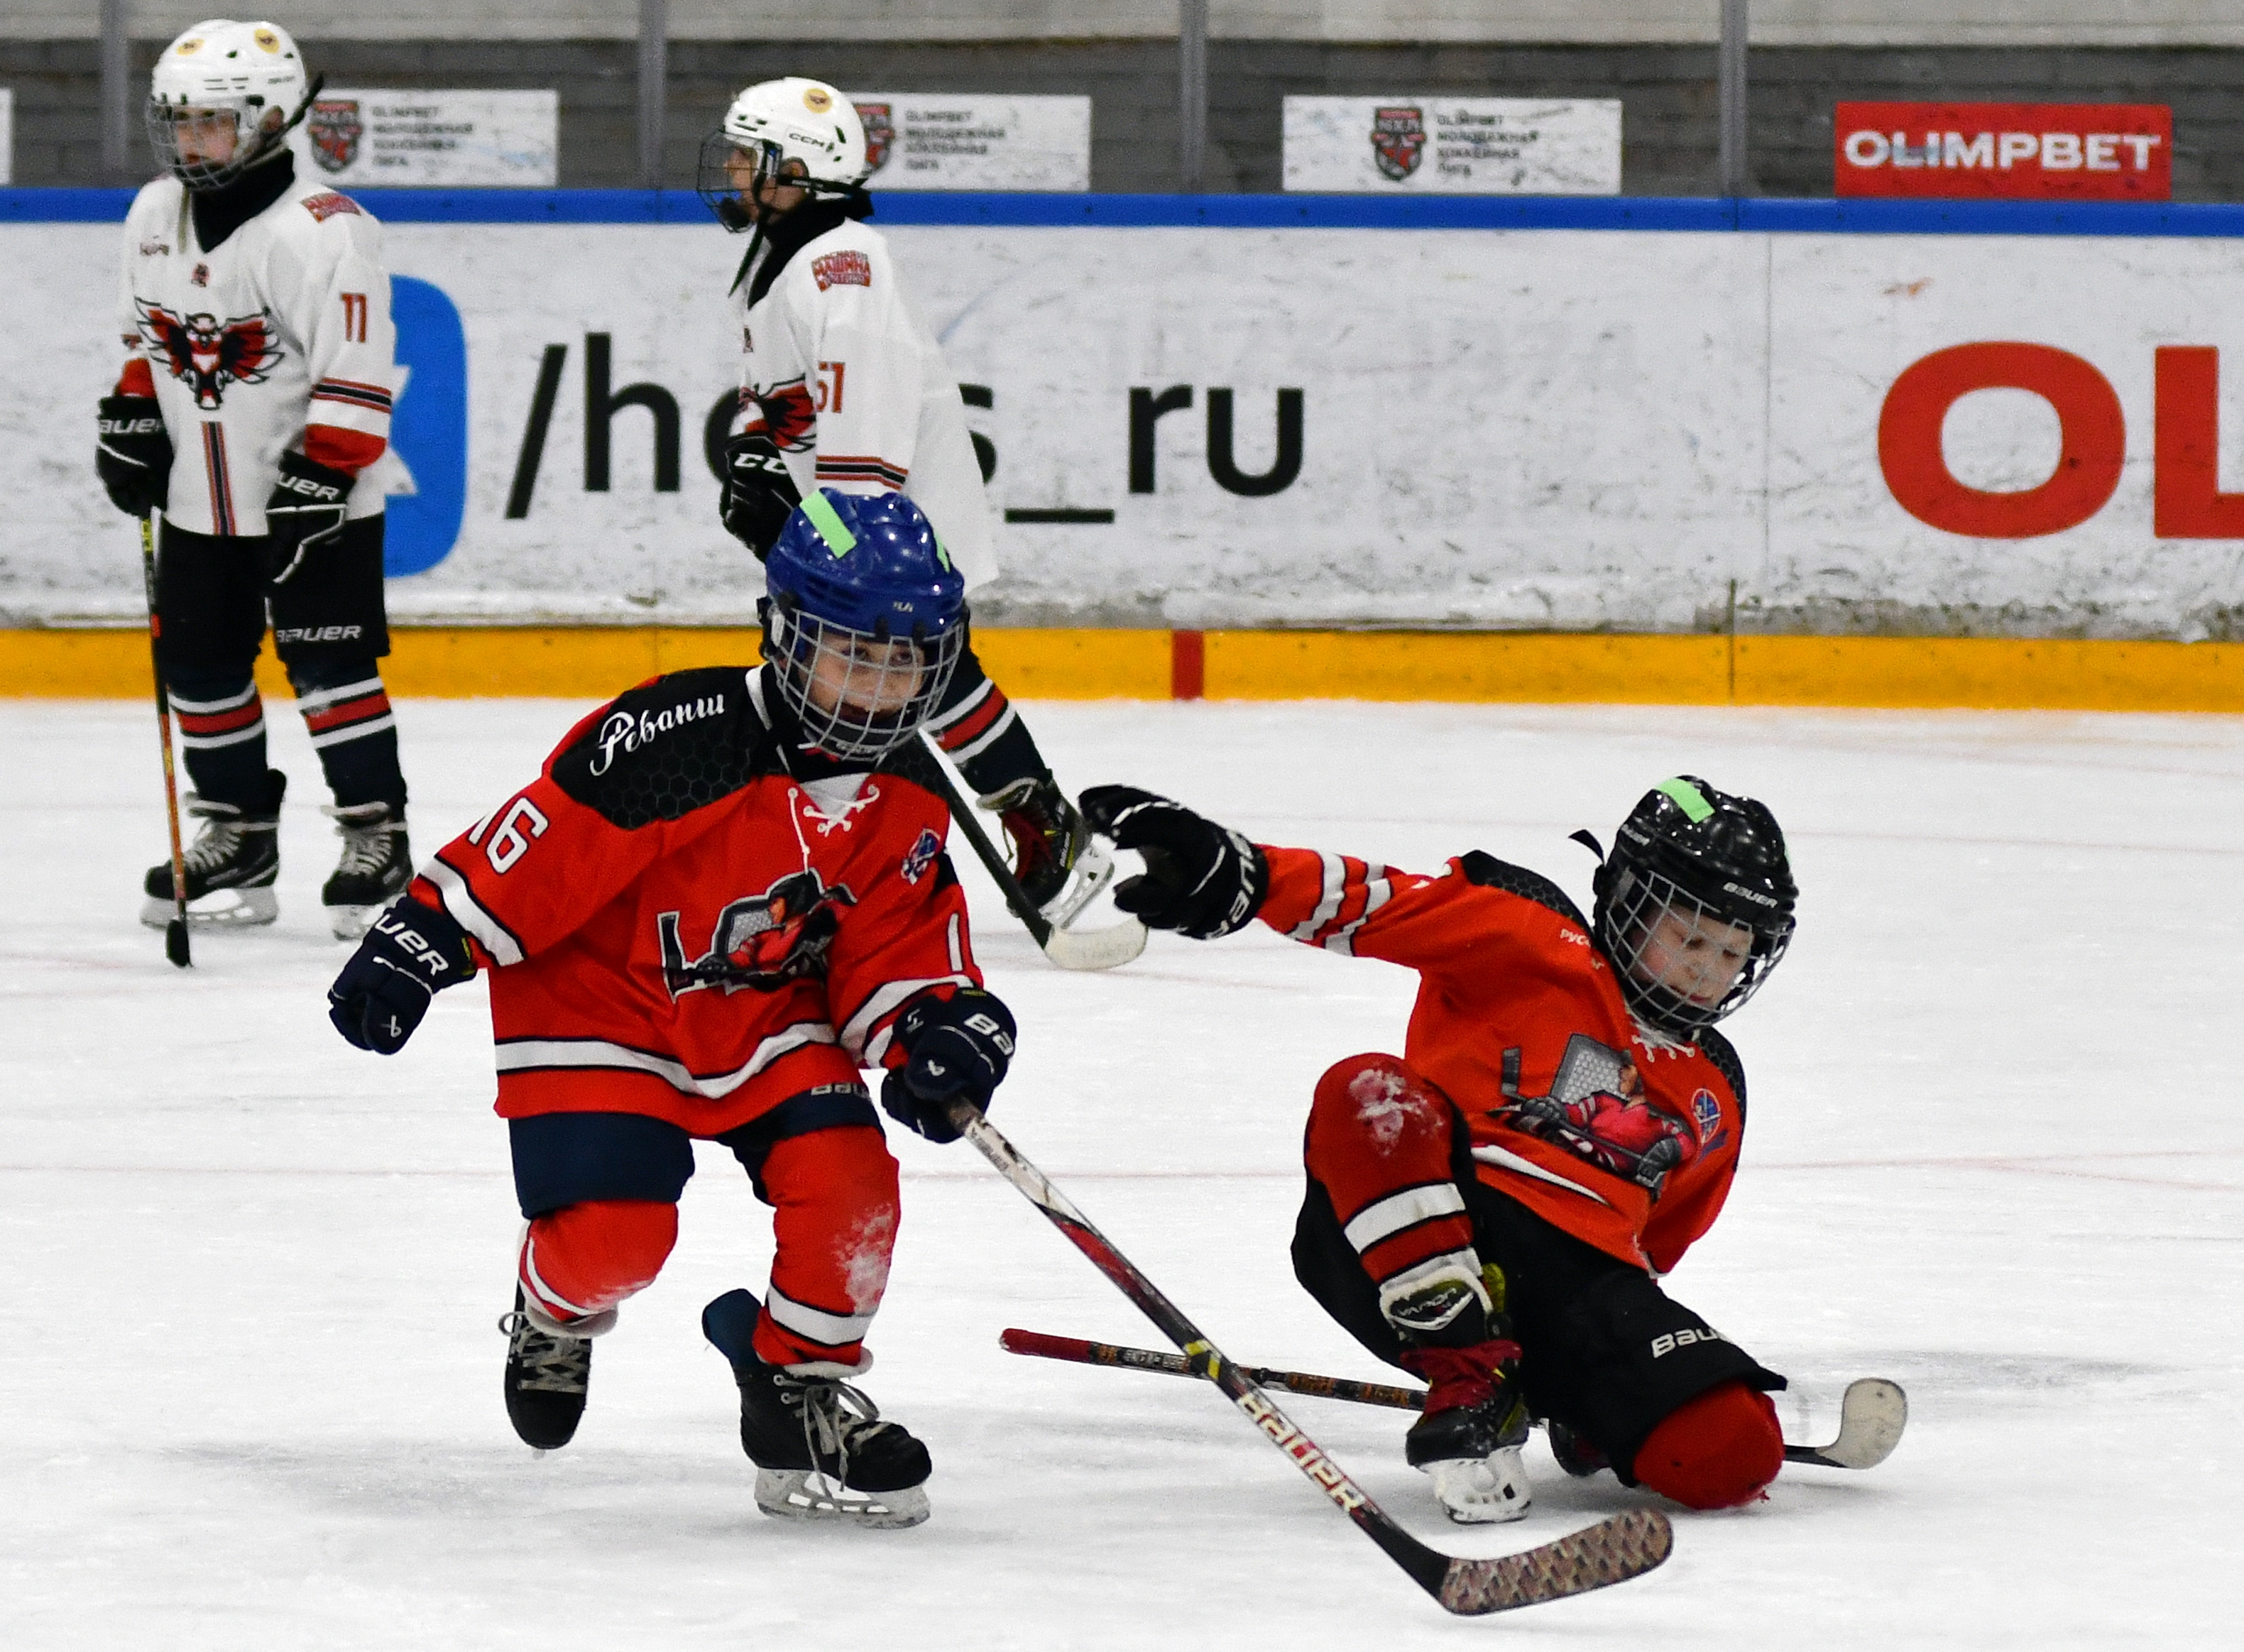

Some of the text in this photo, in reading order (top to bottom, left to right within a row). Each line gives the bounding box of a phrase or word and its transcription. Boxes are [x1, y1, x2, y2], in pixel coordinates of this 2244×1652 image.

[789, 133, 824, 147] CCM
[1844, 130, 2162, 173] OLIMPBET
[339, 292, 367, 342] 11
[734, 453, 789, 475] CC
[590, 693, 725, 777] Реванш
[467, 796, 549, 875] 16
[1723, 882, 1778, 909] BAUER
[1237, 1391, 1366, 1513] BAUER
